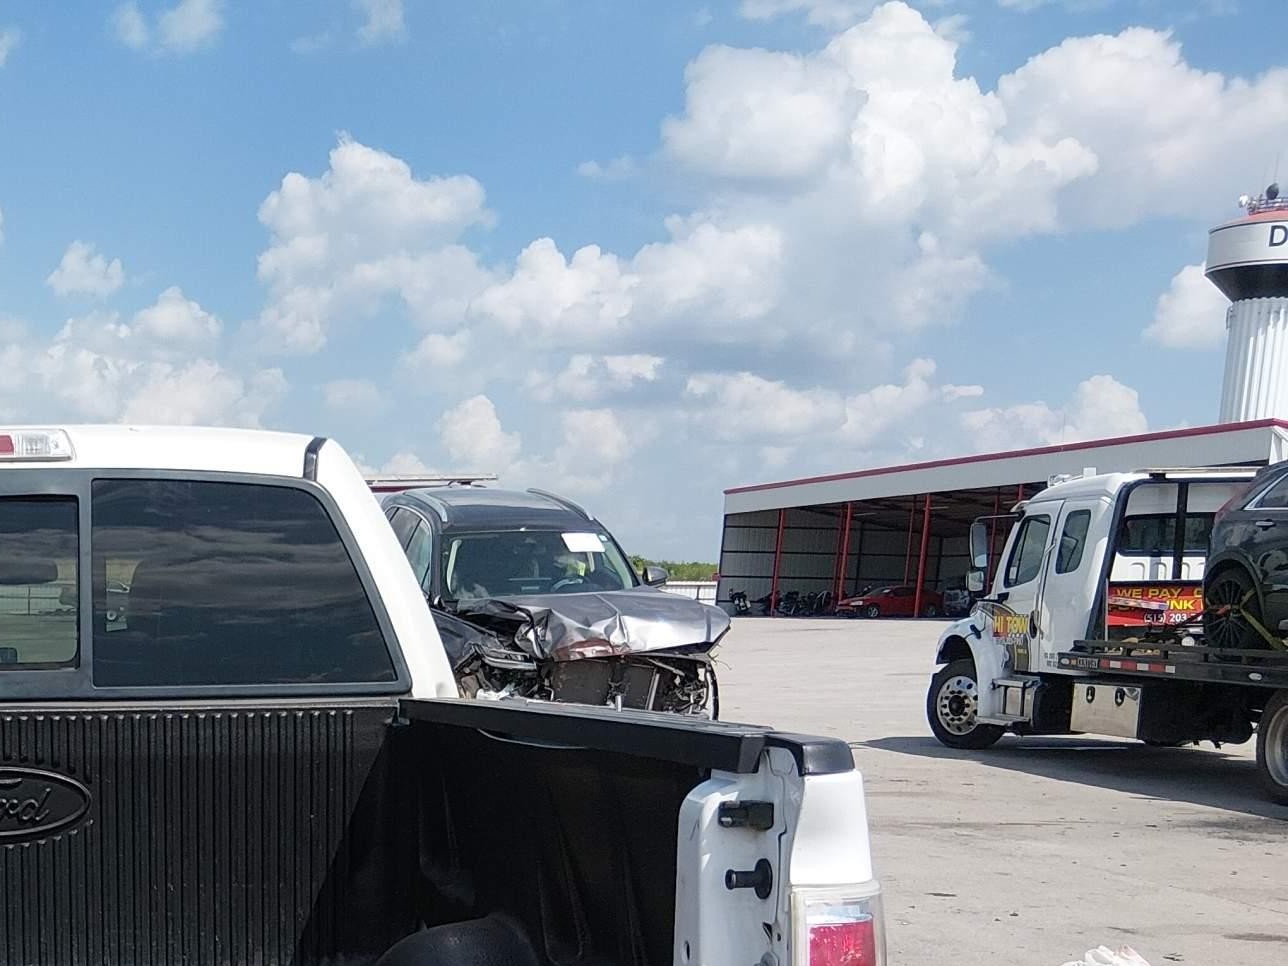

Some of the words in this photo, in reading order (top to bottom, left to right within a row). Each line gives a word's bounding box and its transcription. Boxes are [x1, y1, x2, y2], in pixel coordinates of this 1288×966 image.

[1117, 588, 1142, 598] WE
[1148, 588, 1182, 598] PAY
[994, 615, 1004, 633] HI
[1006, 616, 1028, 633] TOW
